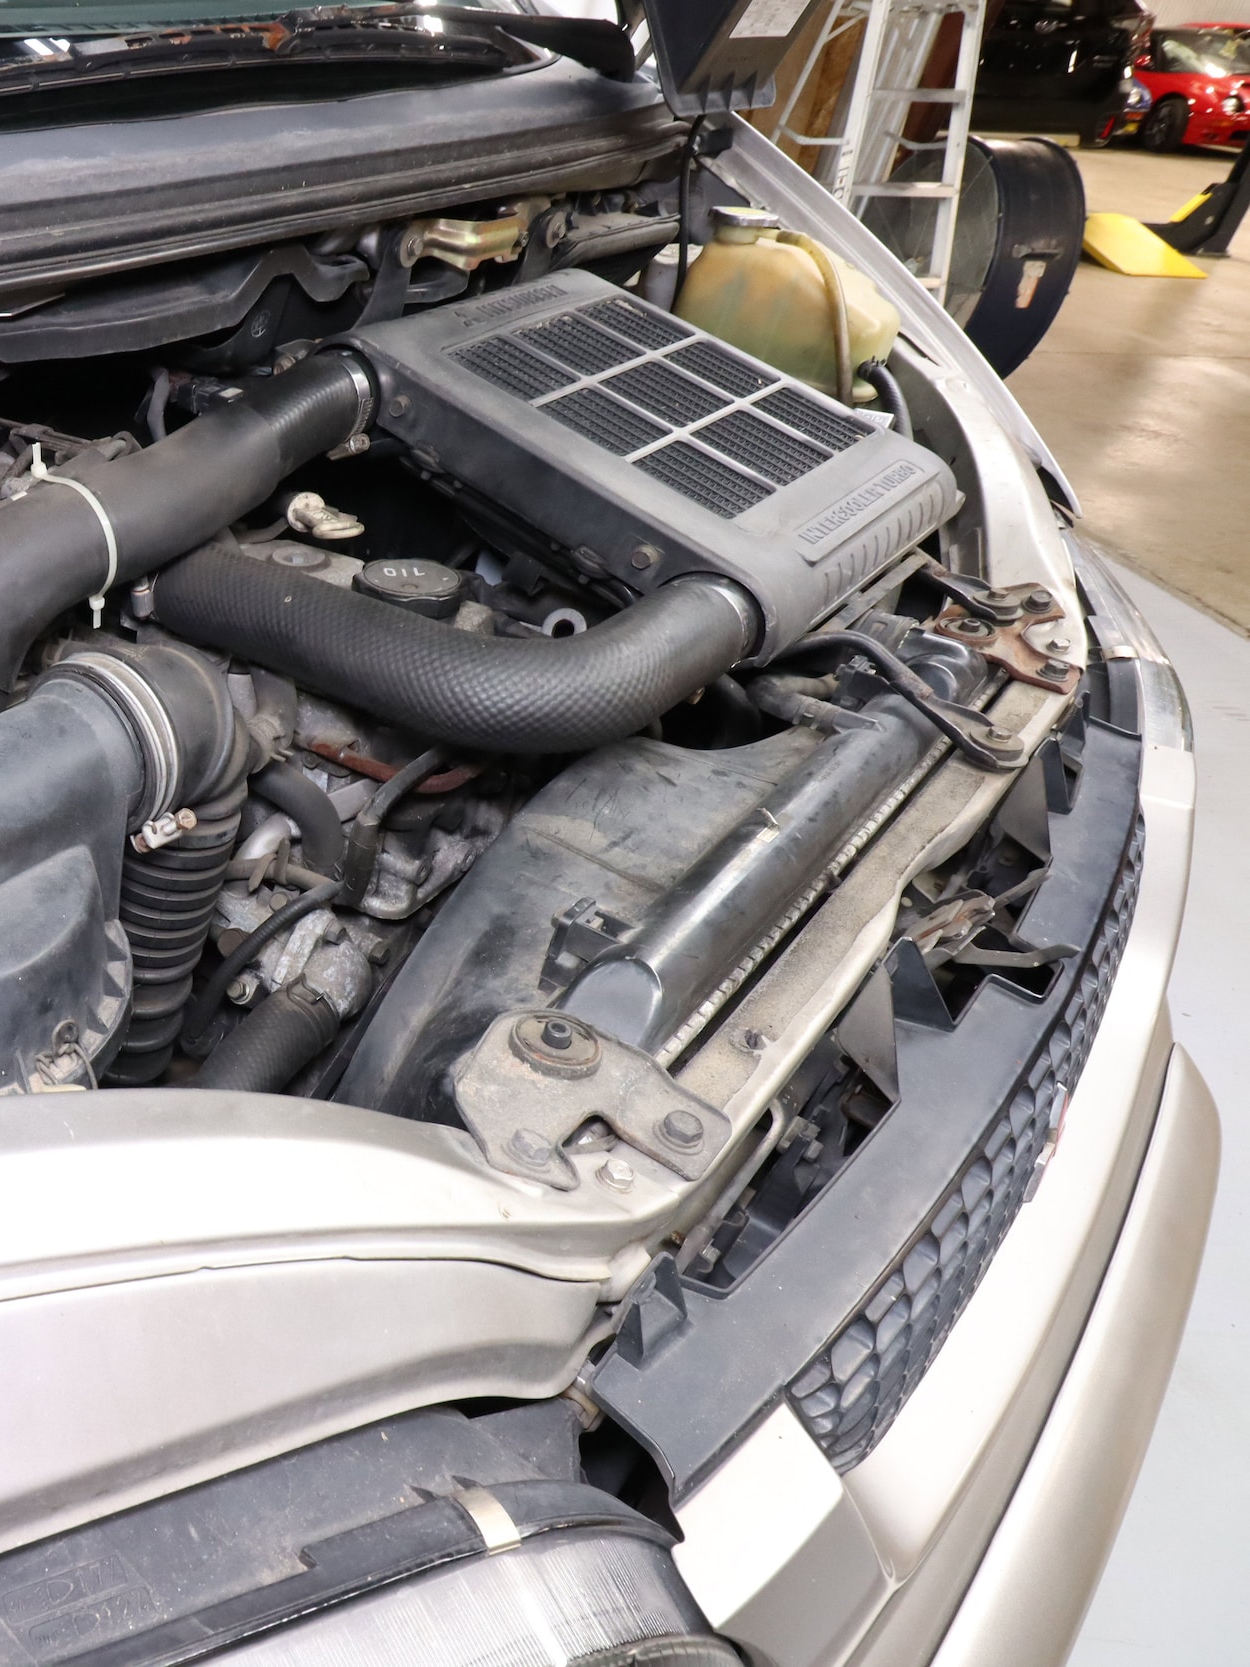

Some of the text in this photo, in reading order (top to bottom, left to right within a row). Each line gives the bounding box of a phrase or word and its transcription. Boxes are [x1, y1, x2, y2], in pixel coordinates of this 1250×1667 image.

[798, 464, 917, 545] INTERCOOLER TURBO
[383, 567, 426, 577] OIL
